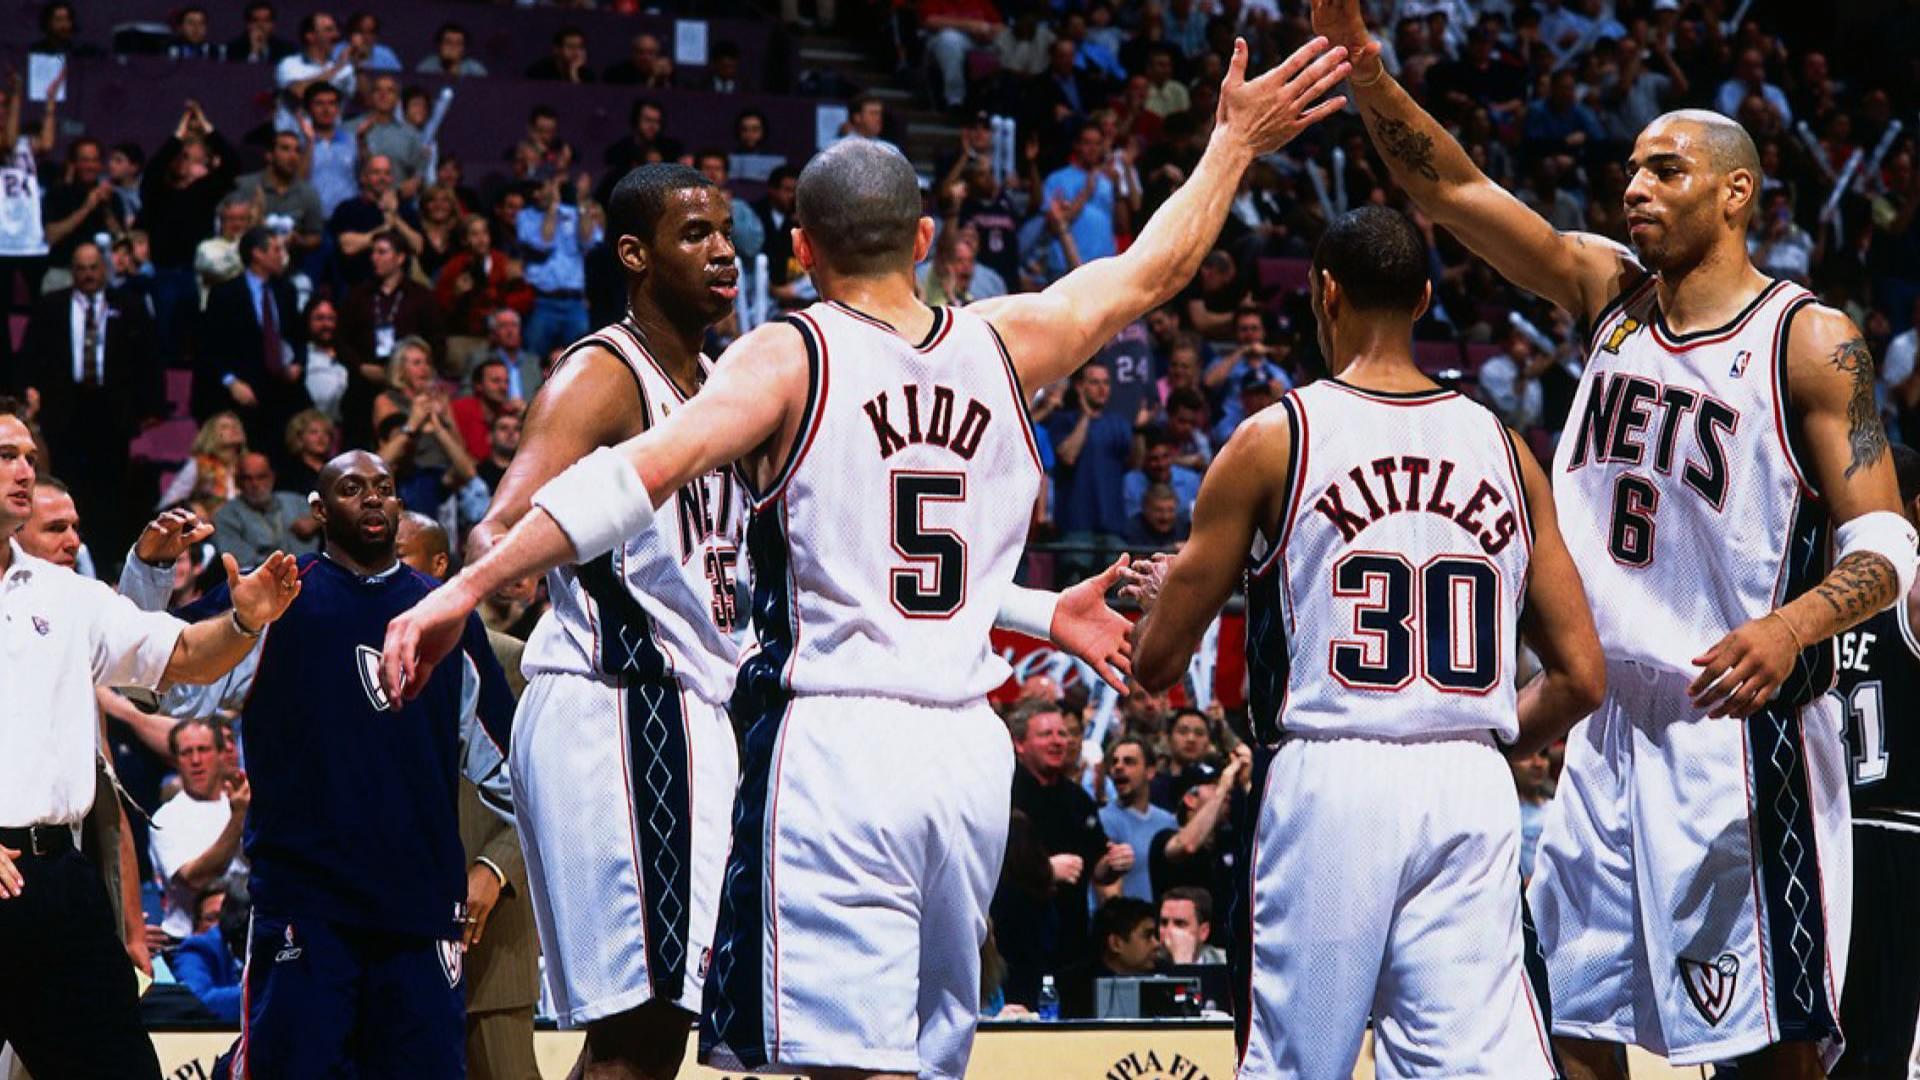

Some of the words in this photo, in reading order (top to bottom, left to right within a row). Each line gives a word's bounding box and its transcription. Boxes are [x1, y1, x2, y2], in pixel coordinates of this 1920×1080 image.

[1115, 355, 1149, 383] 24
[863, 384, 992, 460] KIDD
[1566, 372, 1740, 514] NETS
[890, 470, 968, 620] 5
[1314, 456, 1518, 556] KITTLES
[1607, 471, 1661, 569] 6
[704, 545, 738, 634] 35
[1328, 549, 1502, 696] 30
